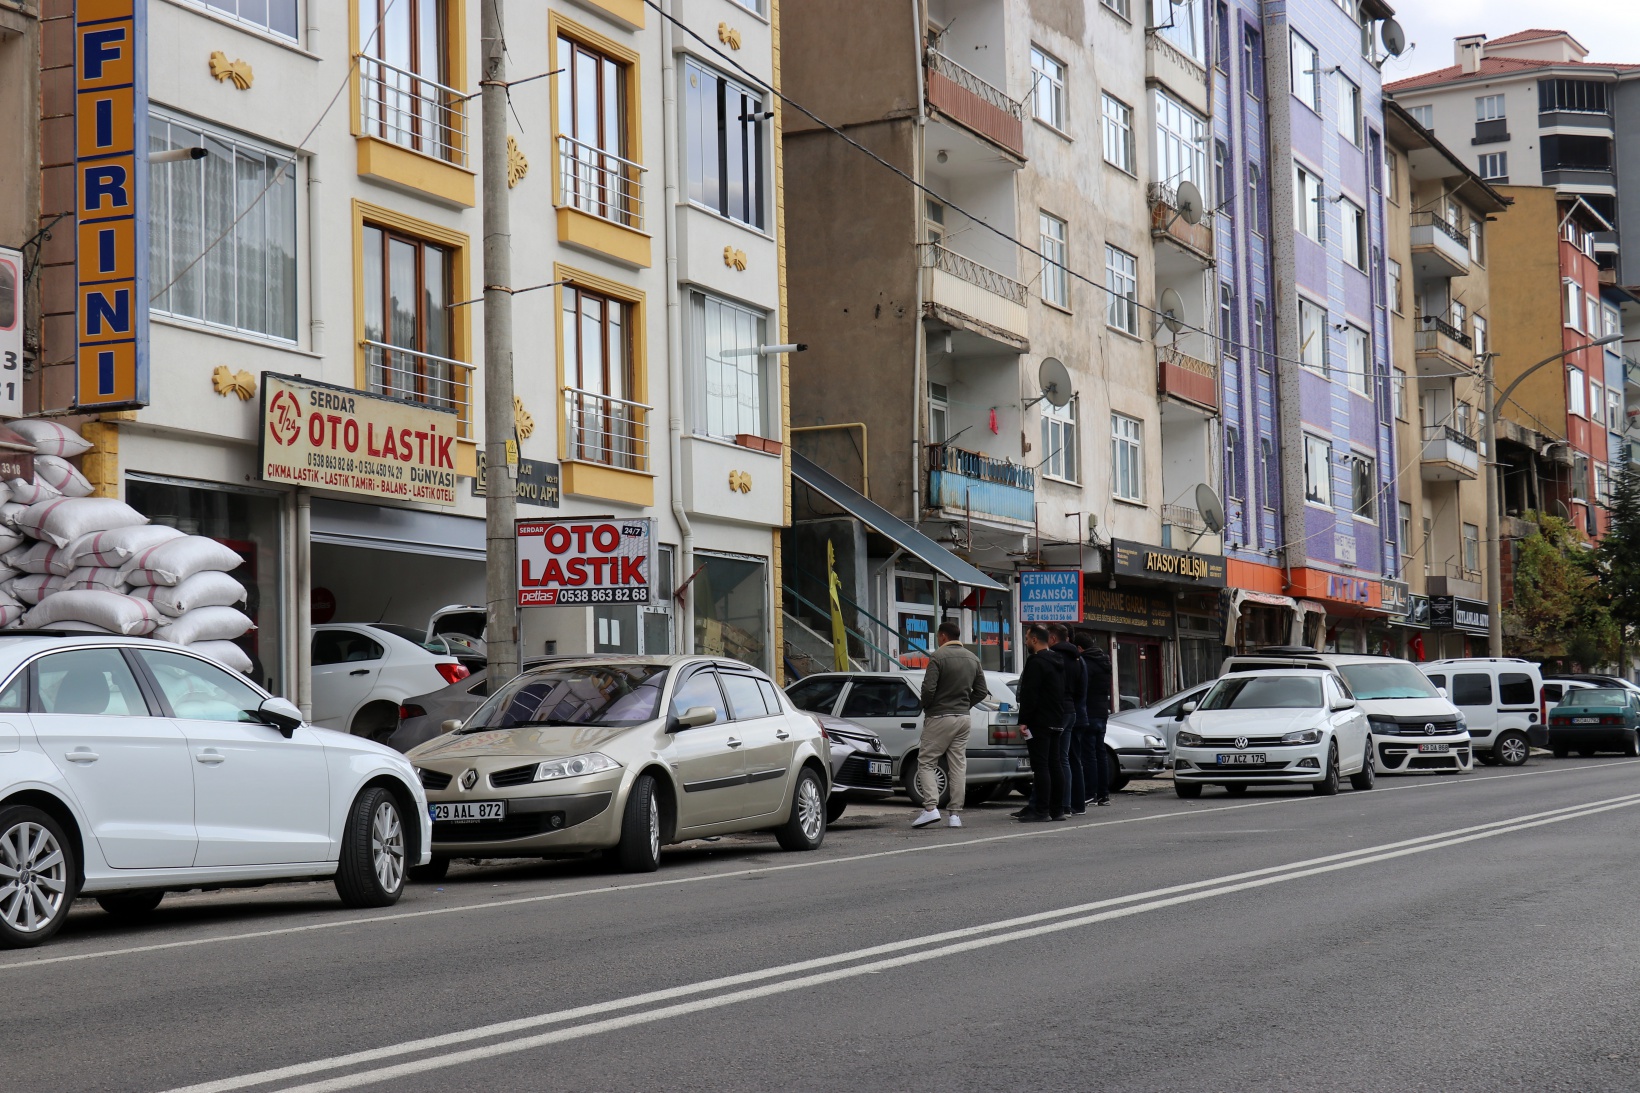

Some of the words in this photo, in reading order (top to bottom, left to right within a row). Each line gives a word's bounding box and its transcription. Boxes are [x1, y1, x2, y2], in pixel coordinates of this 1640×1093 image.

[0, 382, 15, 401] 1
[310, 390, 355, 414] SERDAR
[308, 412, 359, 453] OTO
[313, 453, 324, 468] 538
[325, 455, 337, 471] 863
[337, 456, 346, 472] 82
[346, 458, 354, 472] 68
[364, 460, 376, 475] 534
[376, 463, 387, 478] 450
[387, 466, 395, 479] 94
[396, 466, 403, 480] 29
[381, 479, 407, 495] BALANS
[520, 526, 544, 534] SERDAR
[623, 526, 641, 536] 24/7
[544, 524, 620, 555] OTO
[1146, 552, 1179, 574] ATASOY
[521, 590, 554, 604] petlas
[560, 590, 588, 602] 0538
[592, 589, 612, 602] 863
[616, 588, 630, 601] 82
[632, 588, 647, 600] 68
[1028, 586, 1074, 600] ASANSÖR
[1222, 755, 1230, 763] 07
[1252, 754, 1264, 763] 175
[436, 806, 449, 819] 29
[454, 804, 474, 818] AAL
[479, 804, 501, 817] 872
